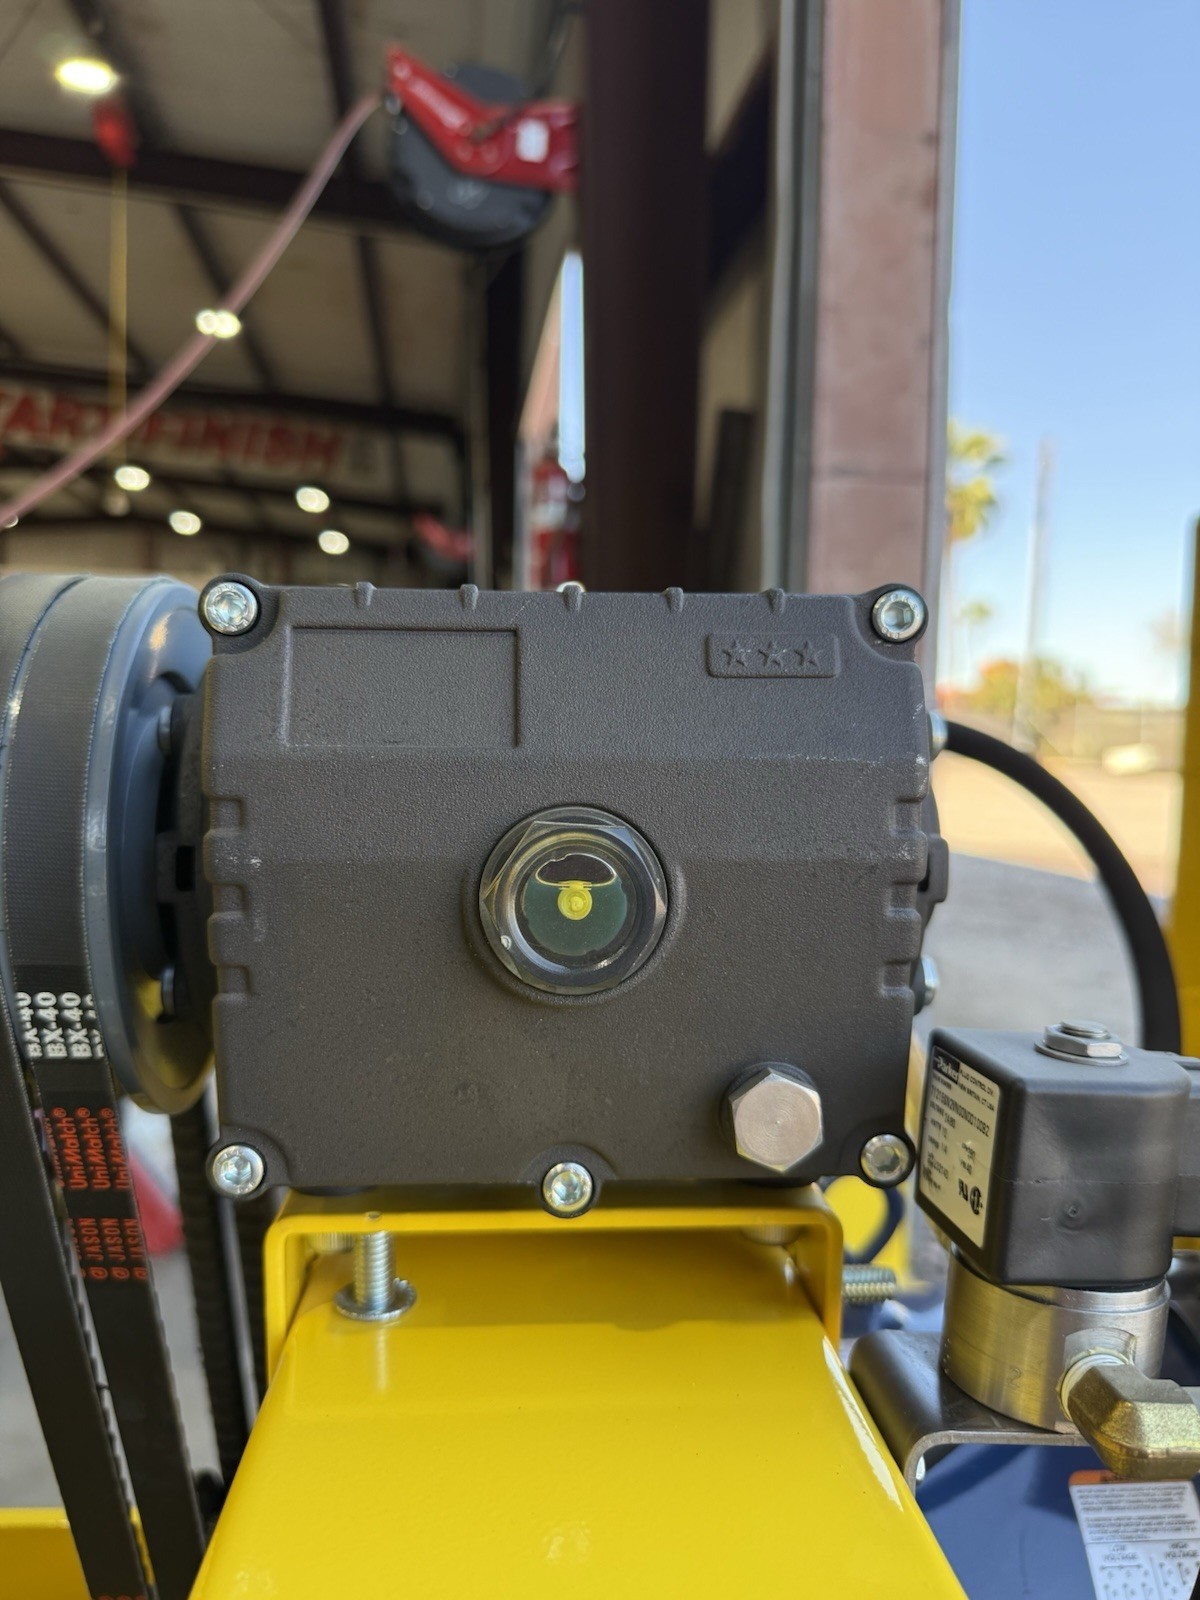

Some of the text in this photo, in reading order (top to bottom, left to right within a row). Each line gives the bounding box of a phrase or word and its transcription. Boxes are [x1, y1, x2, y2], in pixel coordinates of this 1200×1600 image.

[36, 991, 68, 1058] BX-40
[61, 991, 93, 1058] BX-40
[935, 1056, 960, 1083] Parker
[79, 1217, 105, 1260] JASON
[101, 1217, 126, 1260] JASON
